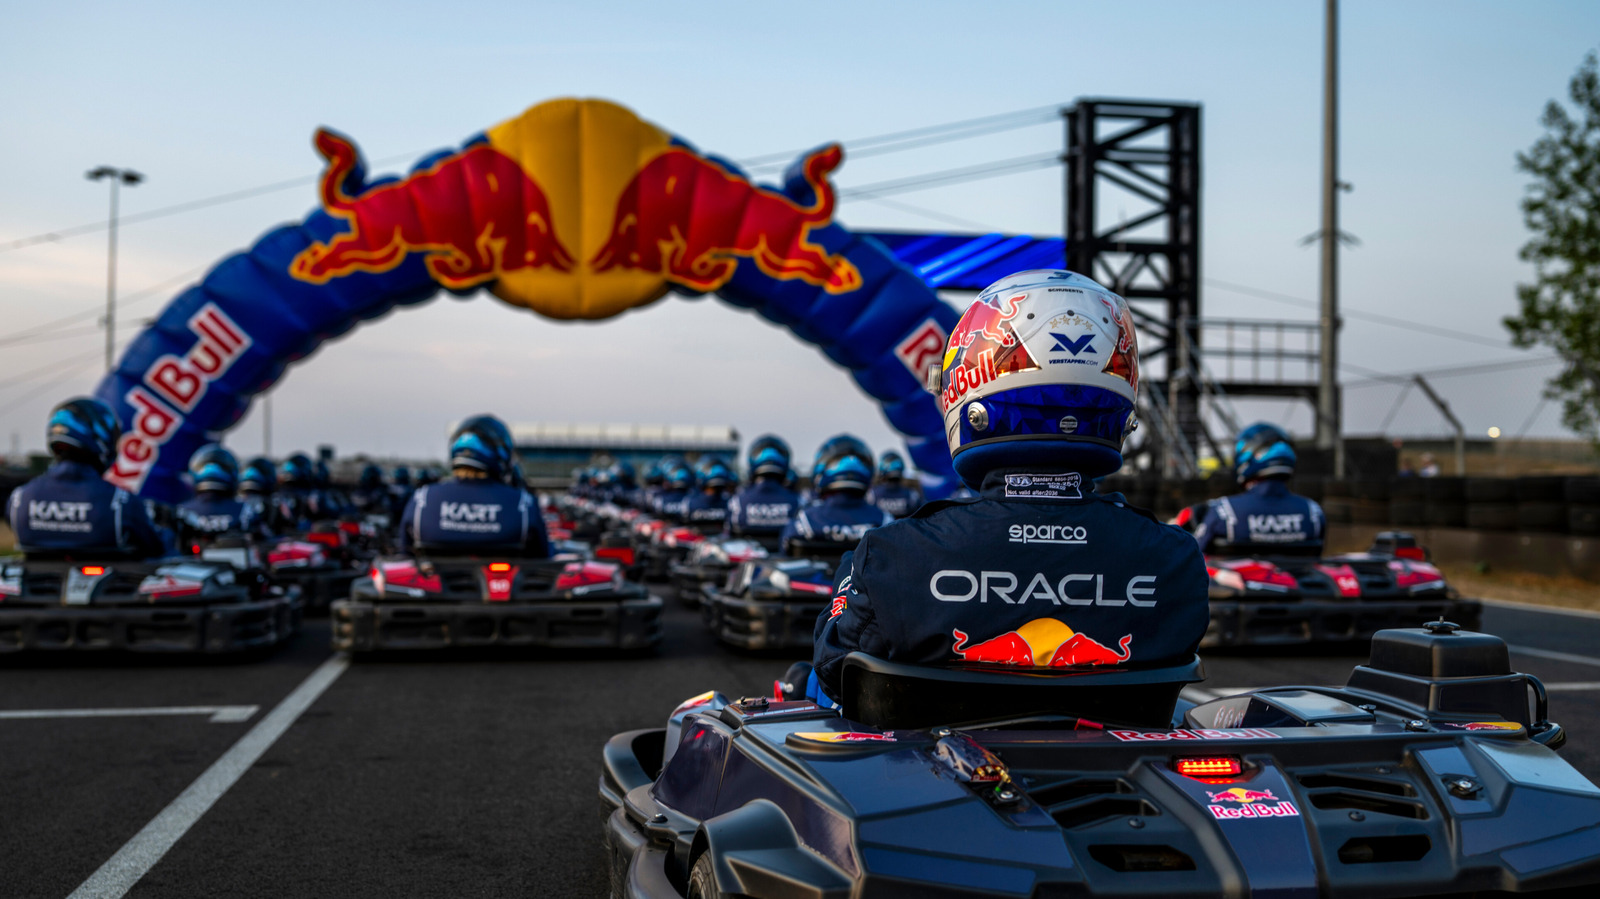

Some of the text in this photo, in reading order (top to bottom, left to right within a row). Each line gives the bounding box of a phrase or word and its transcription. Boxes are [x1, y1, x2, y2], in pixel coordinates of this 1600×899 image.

[148, 305, 250, 410] Bull
[1048, 359, 1099, 367] VERSTAPPEN.COM
[942, 349, 996, 412] ed Bull
[1009, 476, 1032, 487] FIA
[29, 500, 93, 521] KART
[440, 501, 503, 522] KART
[1247, 514, 1305, 533] KART
[1009, 524, 1088, 544] sparco
[930, 570, 1158, 607] ORACLE
[1109, 729, 1281, 741] Red Bull
[1208, 801, 1299, 819] Red Bull
